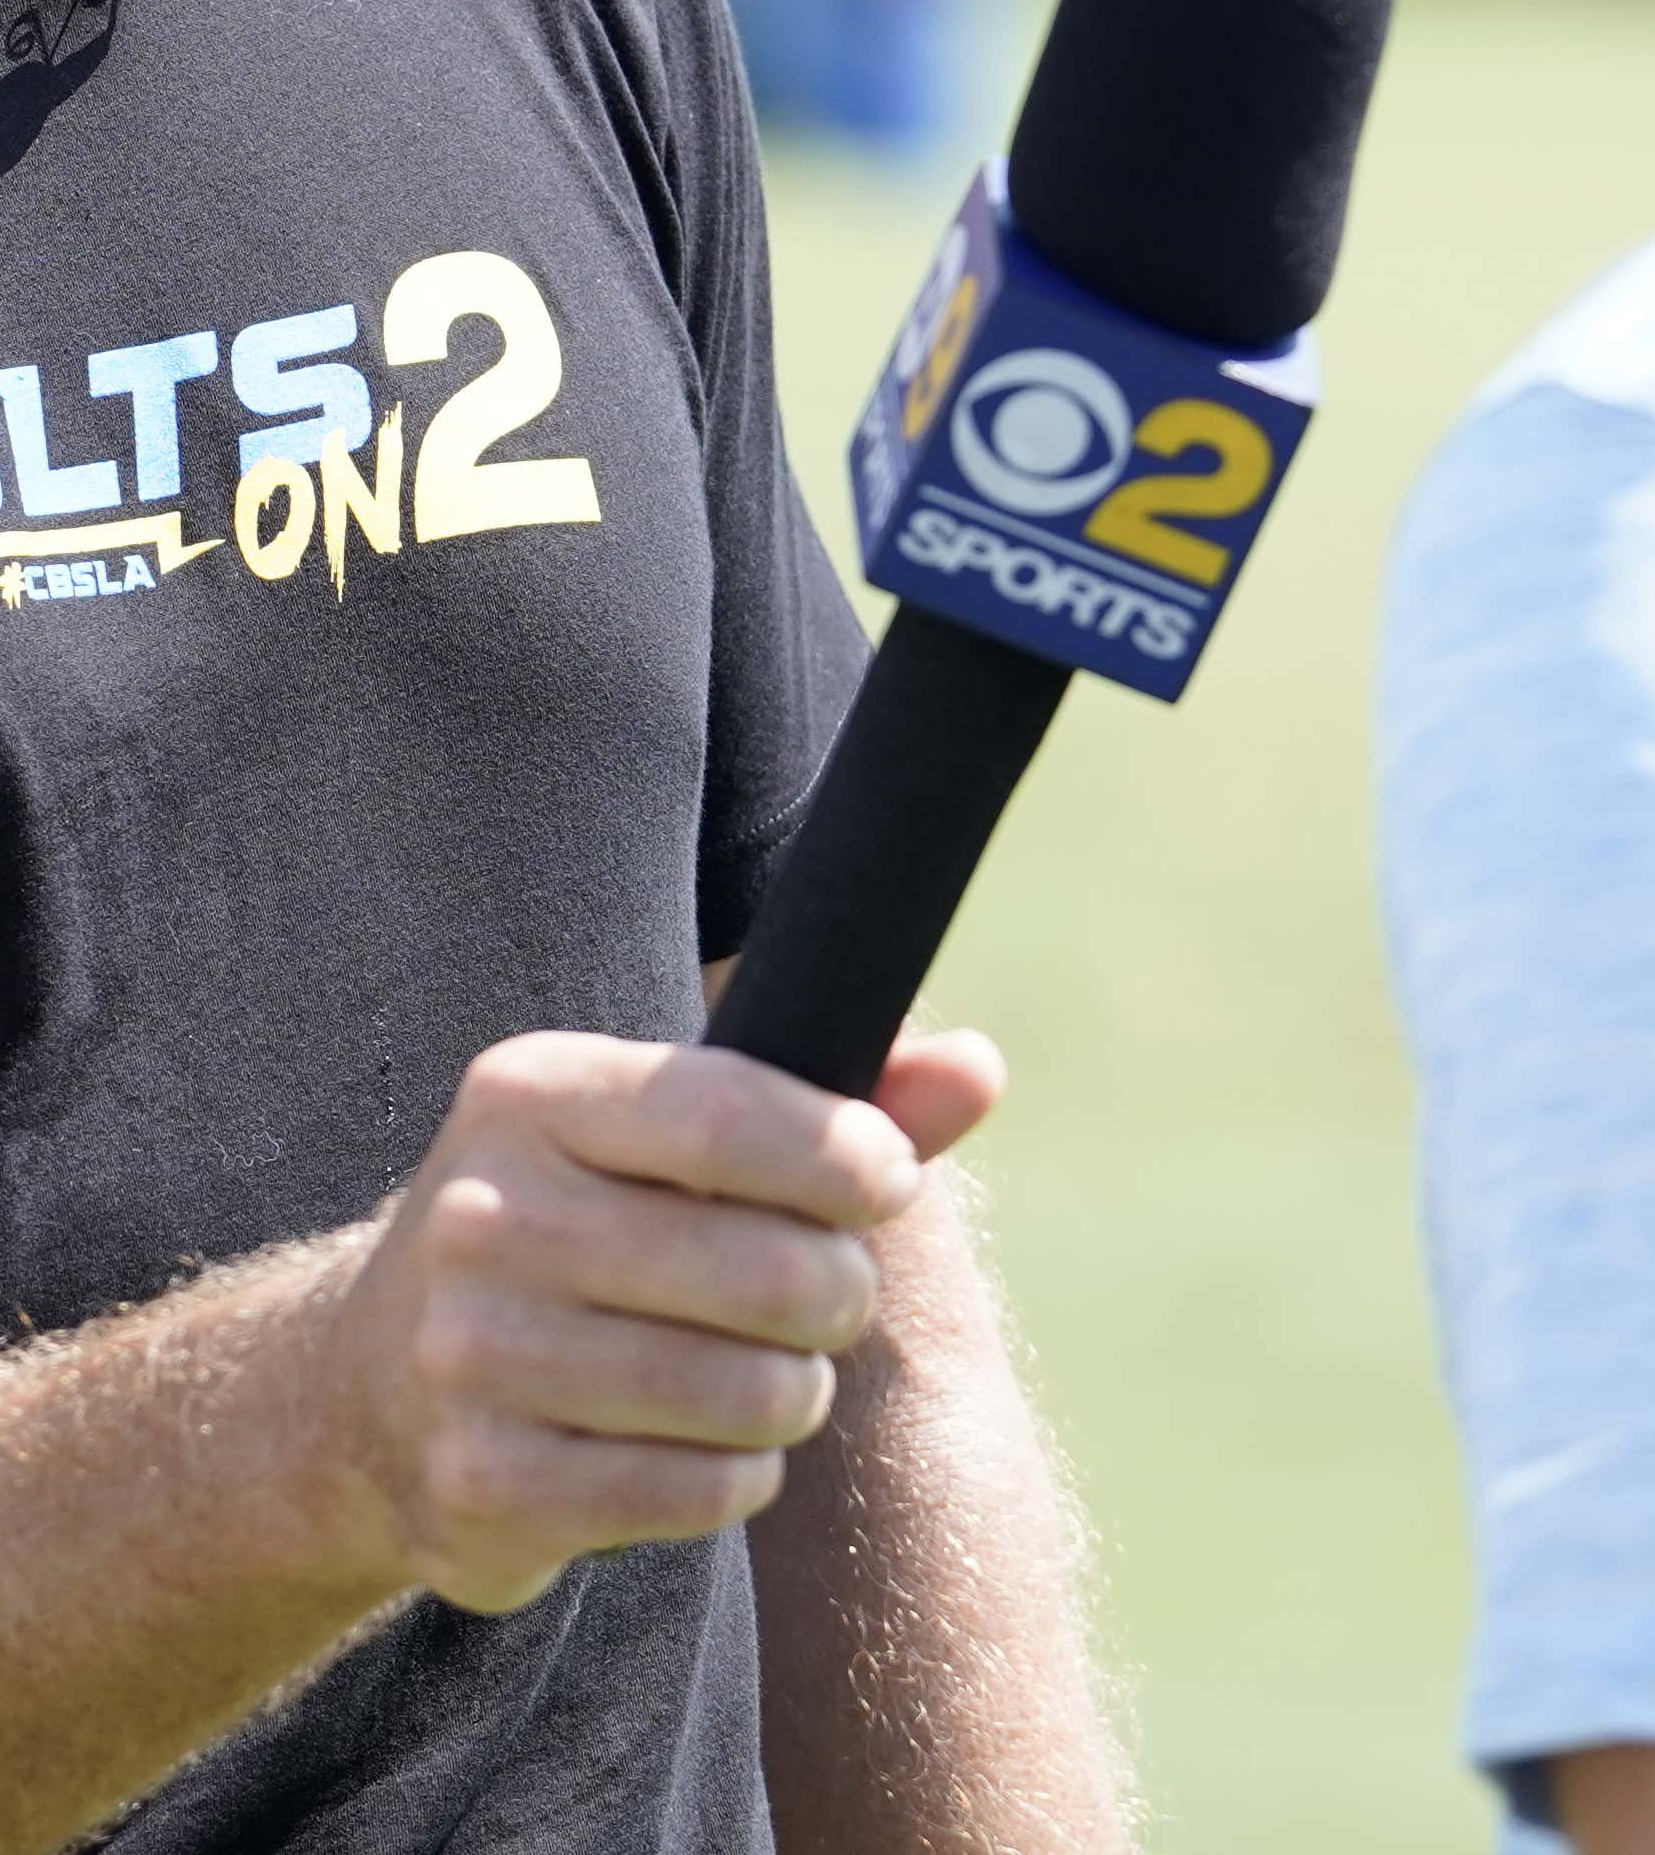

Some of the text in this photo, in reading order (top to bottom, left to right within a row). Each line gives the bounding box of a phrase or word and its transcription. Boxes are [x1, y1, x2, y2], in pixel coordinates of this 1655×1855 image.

[233, 401, 404, 602] ON
[383, 251, 601, 543] 2
[1083, 398, 1275, 587] 2
[898, 507, 1199, 660] SPORTS
